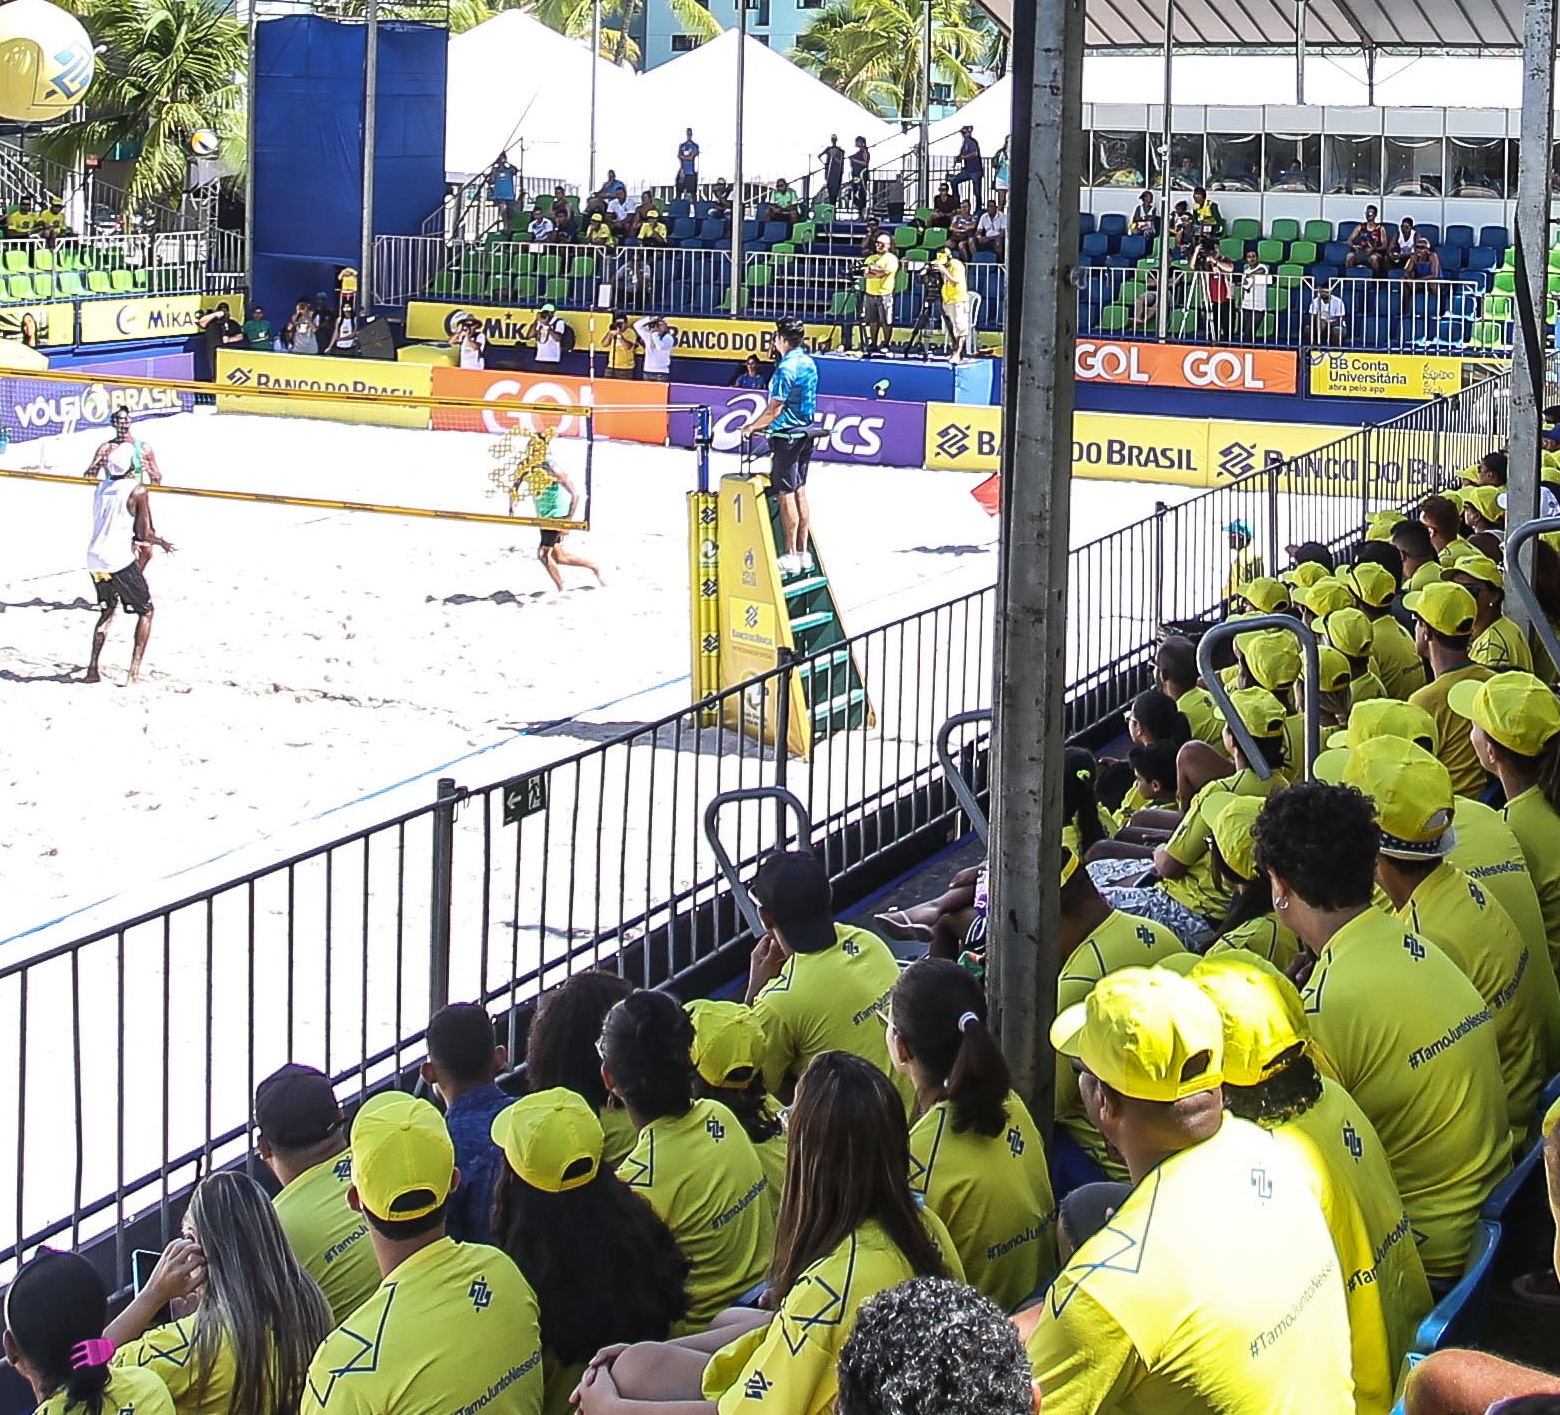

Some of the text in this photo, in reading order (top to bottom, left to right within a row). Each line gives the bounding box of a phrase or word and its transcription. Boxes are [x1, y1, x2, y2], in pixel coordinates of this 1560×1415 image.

[731, 332, 757, 352] DO
[1074, 343, 1151, 383] GOL
[1182, 350, 1265, 390] GOL
[1329, 357, 1389, 372] BB Conta
[1329, 369, 1407, 385] Universitária
[1106, 438, 1198, 472] BRASIL
[732, 492, 743, 524] 1
